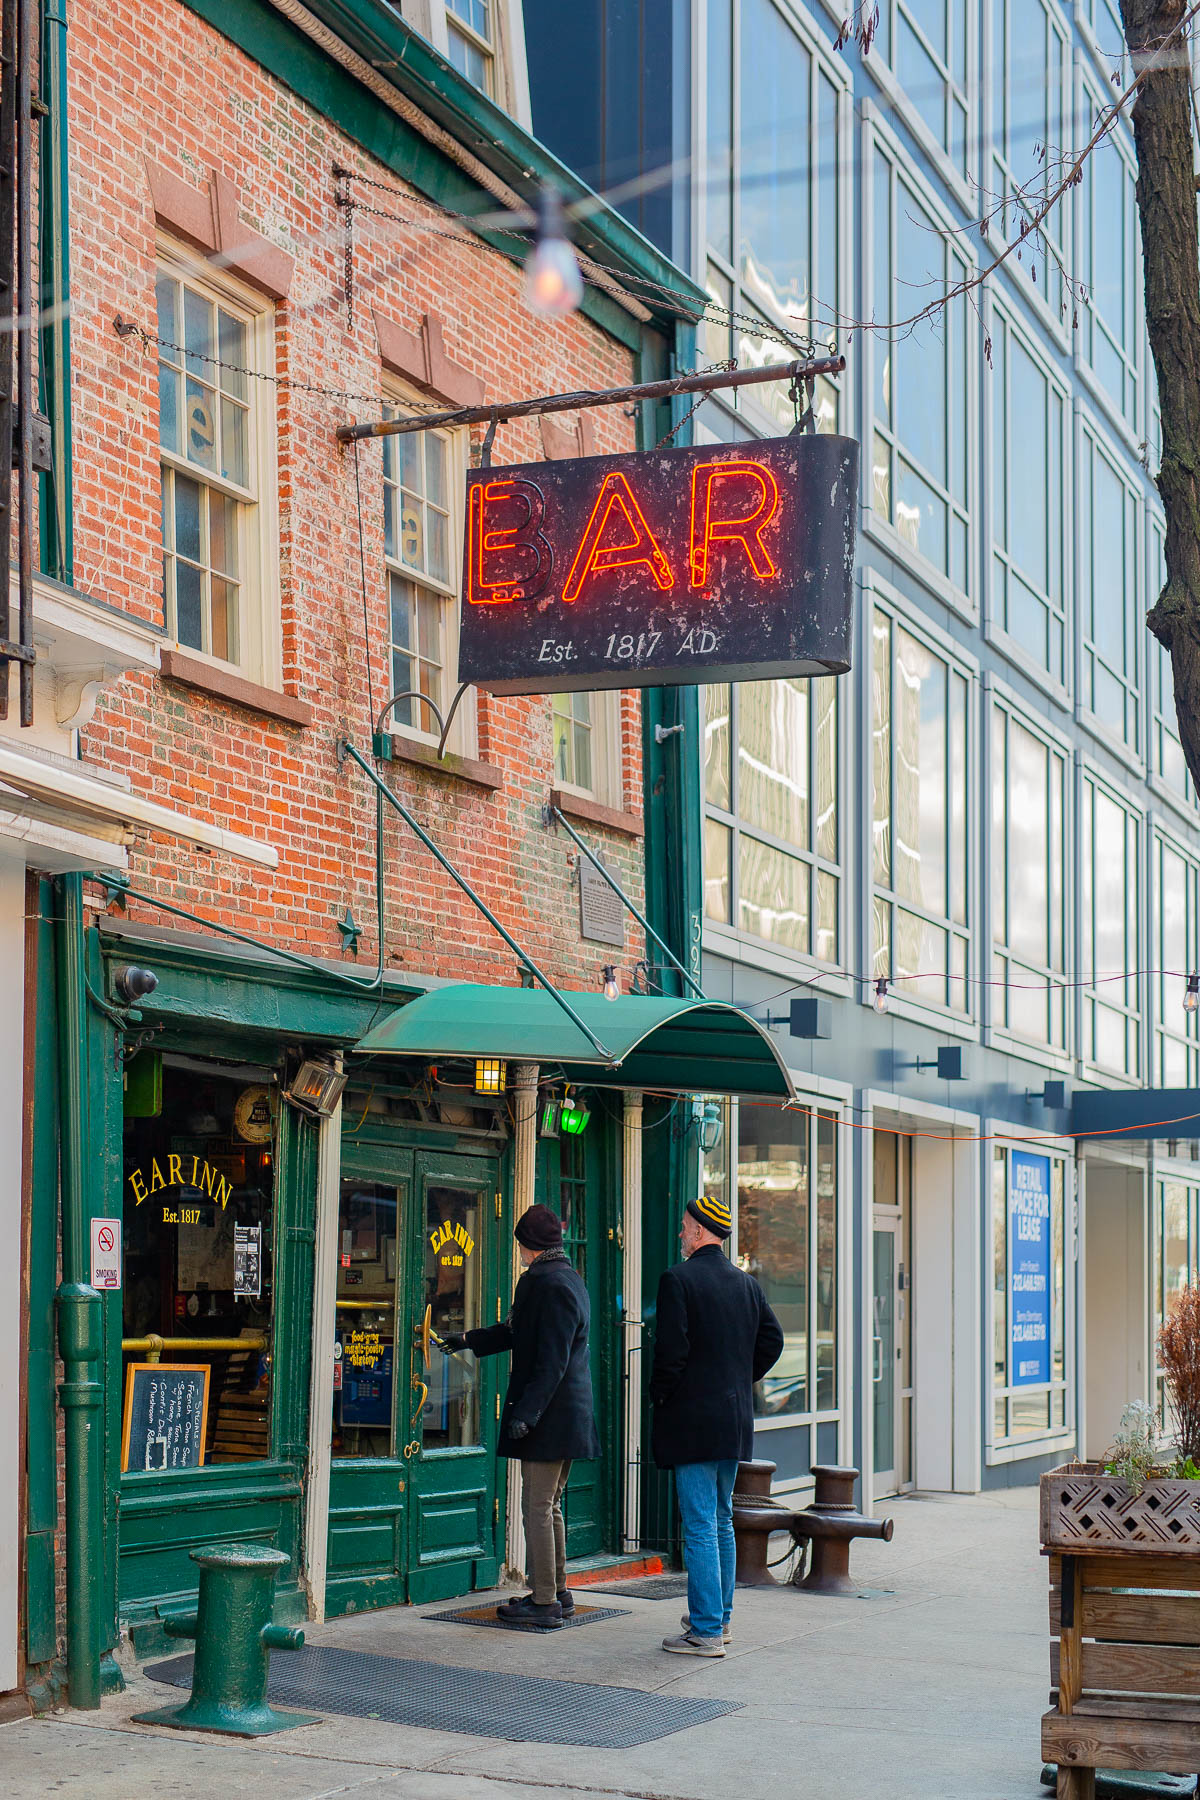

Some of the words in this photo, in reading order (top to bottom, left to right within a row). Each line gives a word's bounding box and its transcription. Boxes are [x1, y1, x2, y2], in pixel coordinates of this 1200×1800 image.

[538, 639, 579, 663] Est.
[603, 631, 662, 660] 1817
[128, 1154, 186, 1207] EAR
[190, 1155, 234, 1211] INN
[1016, 1163, 1042, 1193] RETAIL
[162, 1207, 180, 1223] Est.
[181, 1209, 201, 1225] 1817
[1010, 1188, 1033, 1216] SPACE
[1033, 1191, 1049, 1219] FOR
[430, 1220, 454, 1255] EAR
[454, 1222, 475, 1257] INN
[1017, 1215, 1041, 1242] LEASE
[96, 1269, 117, 1279] SMOKING
[148, 1381, 158, 1424] Mushroom
[159, 1381, 168, 1416] Confit
[166, 1399, 177, 1423] honey
[176, 1383, 185, 1420] Sesame
[186, 1384, 195, 1415] French
[157, 1419, 166, 1438] Duc
[173, 1423, 183, 1444] Tuna
[184, 1421, 192, 1444] Onion
